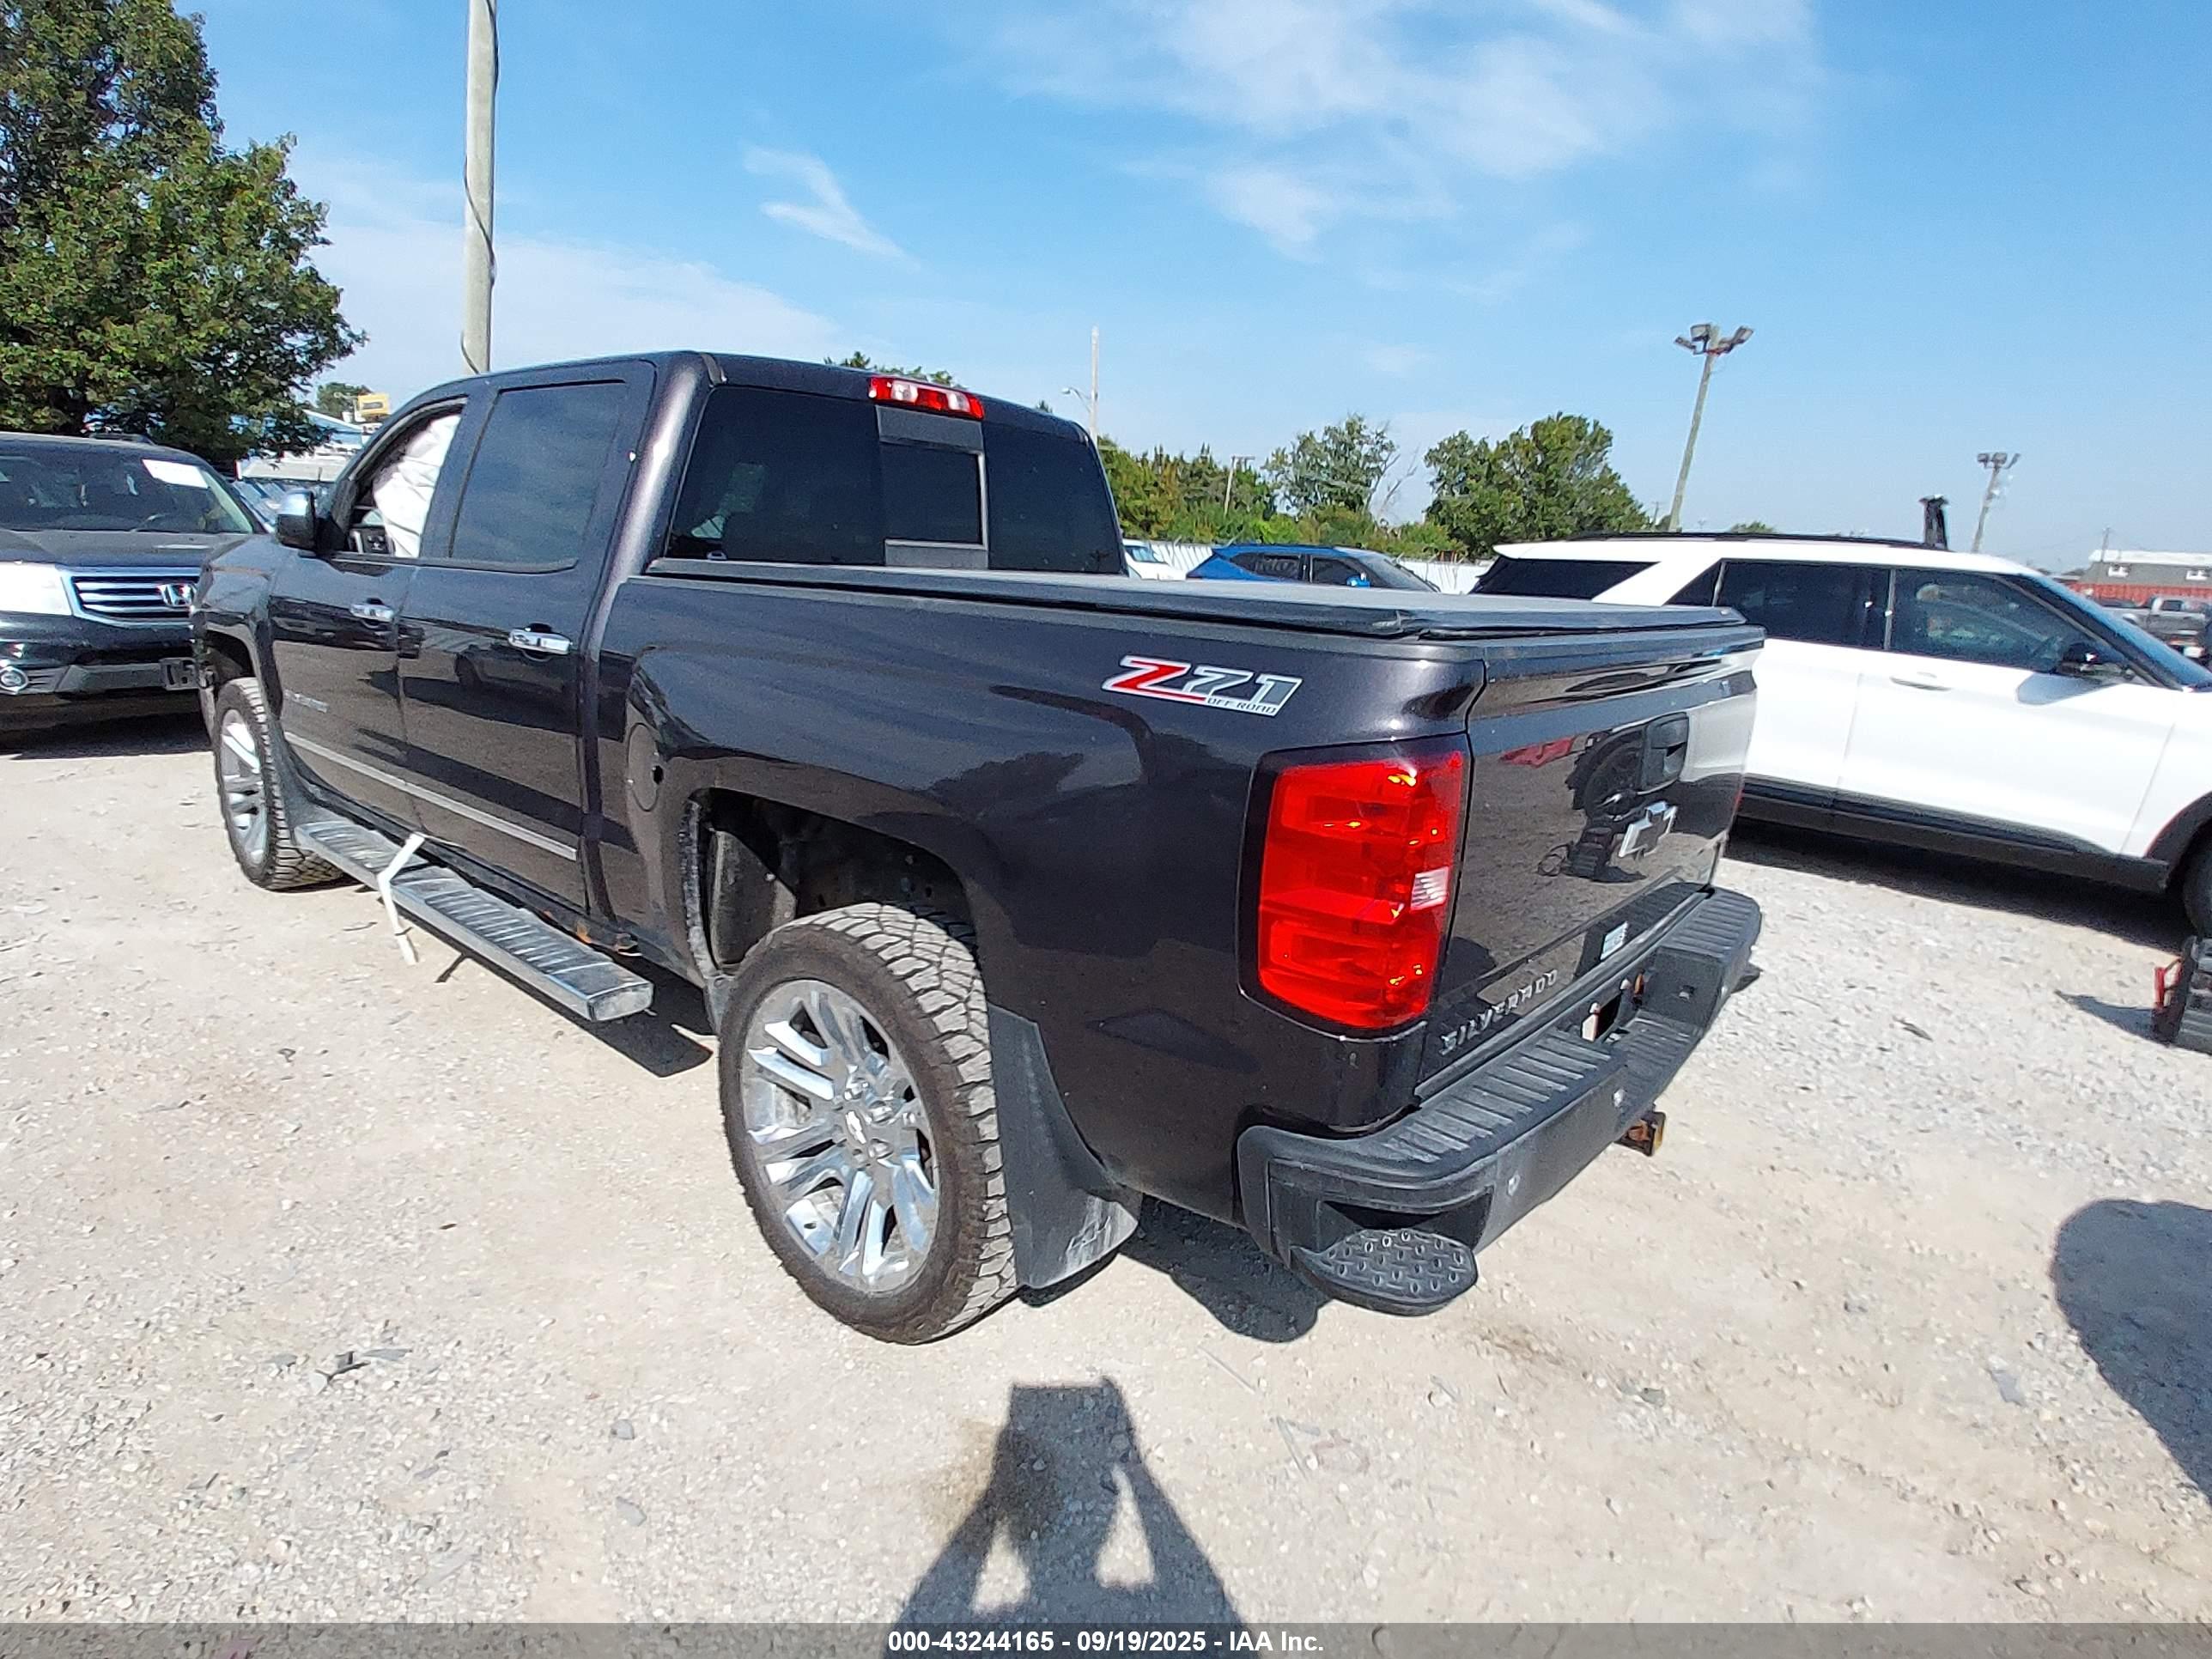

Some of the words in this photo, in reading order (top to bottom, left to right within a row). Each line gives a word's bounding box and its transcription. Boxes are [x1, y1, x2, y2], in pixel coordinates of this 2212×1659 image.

[1101, 654, 1303, 709] Z71
[1206, 696, 1231, 707] OFF
[1236, 702, 1277, 714] ROAD
[1438, 969, 1558, 1056] SILVERADO
